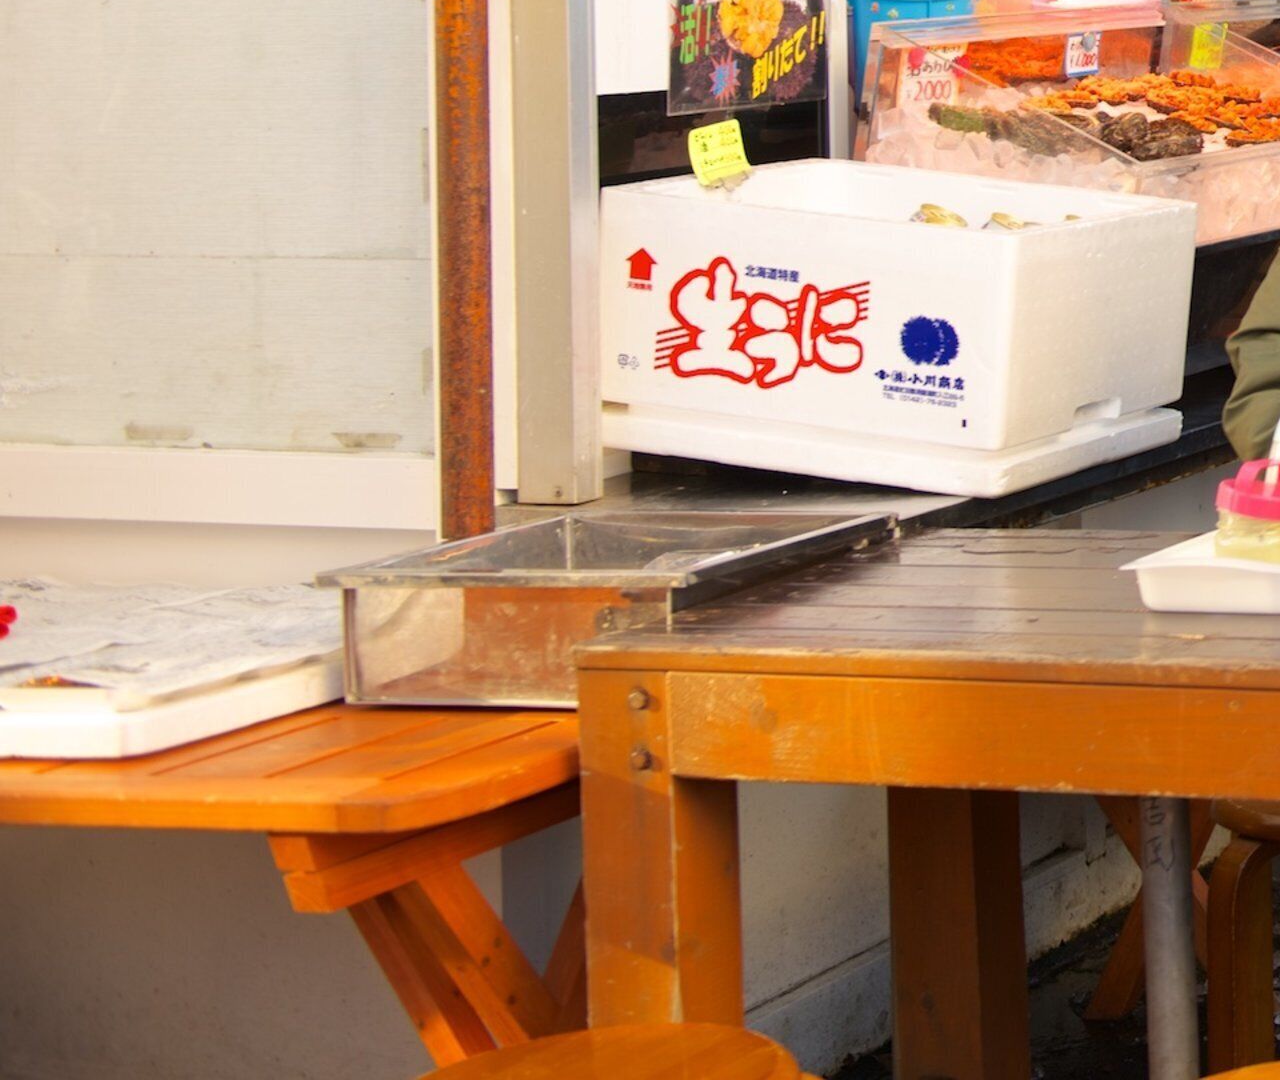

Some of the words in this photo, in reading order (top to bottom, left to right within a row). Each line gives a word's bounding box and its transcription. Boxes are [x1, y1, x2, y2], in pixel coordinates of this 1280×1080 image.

[744, 264, 800, 283] 北海道特産
[669, 256, 864, 389] 生うに
